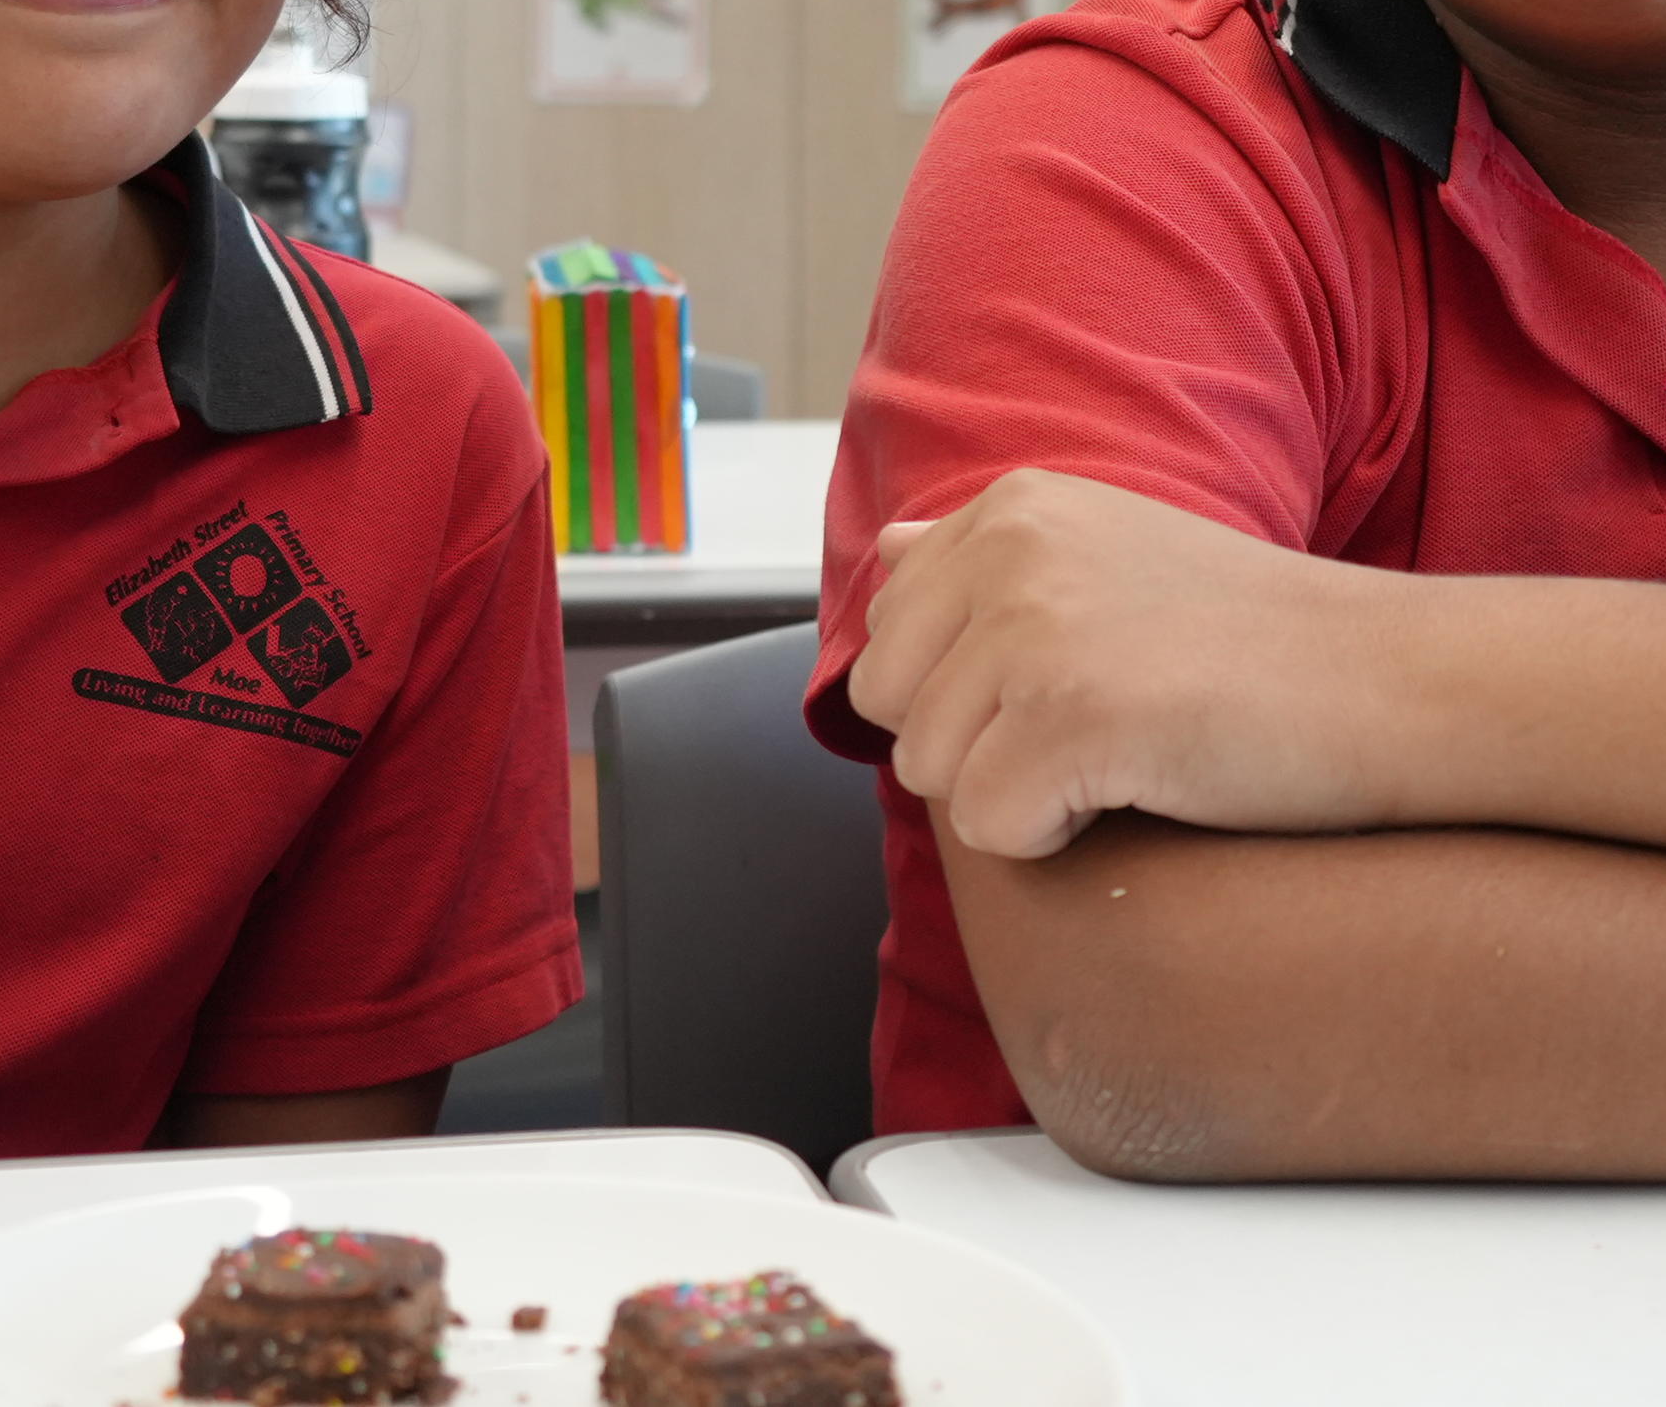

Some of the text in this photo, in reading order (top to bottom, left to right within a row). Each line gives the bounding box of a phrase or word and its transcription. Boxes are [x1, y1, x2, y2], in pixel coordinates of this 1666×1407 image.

[105, 499, 249, 607] Elizabeth Street
[264, 509, 373, 660] Primary School
[82, 672, 146, 706] Living
[152, 688, 192, 712] and
[198, 693, 290, 735] Learning
[209, 666, 262, 694] Moe
